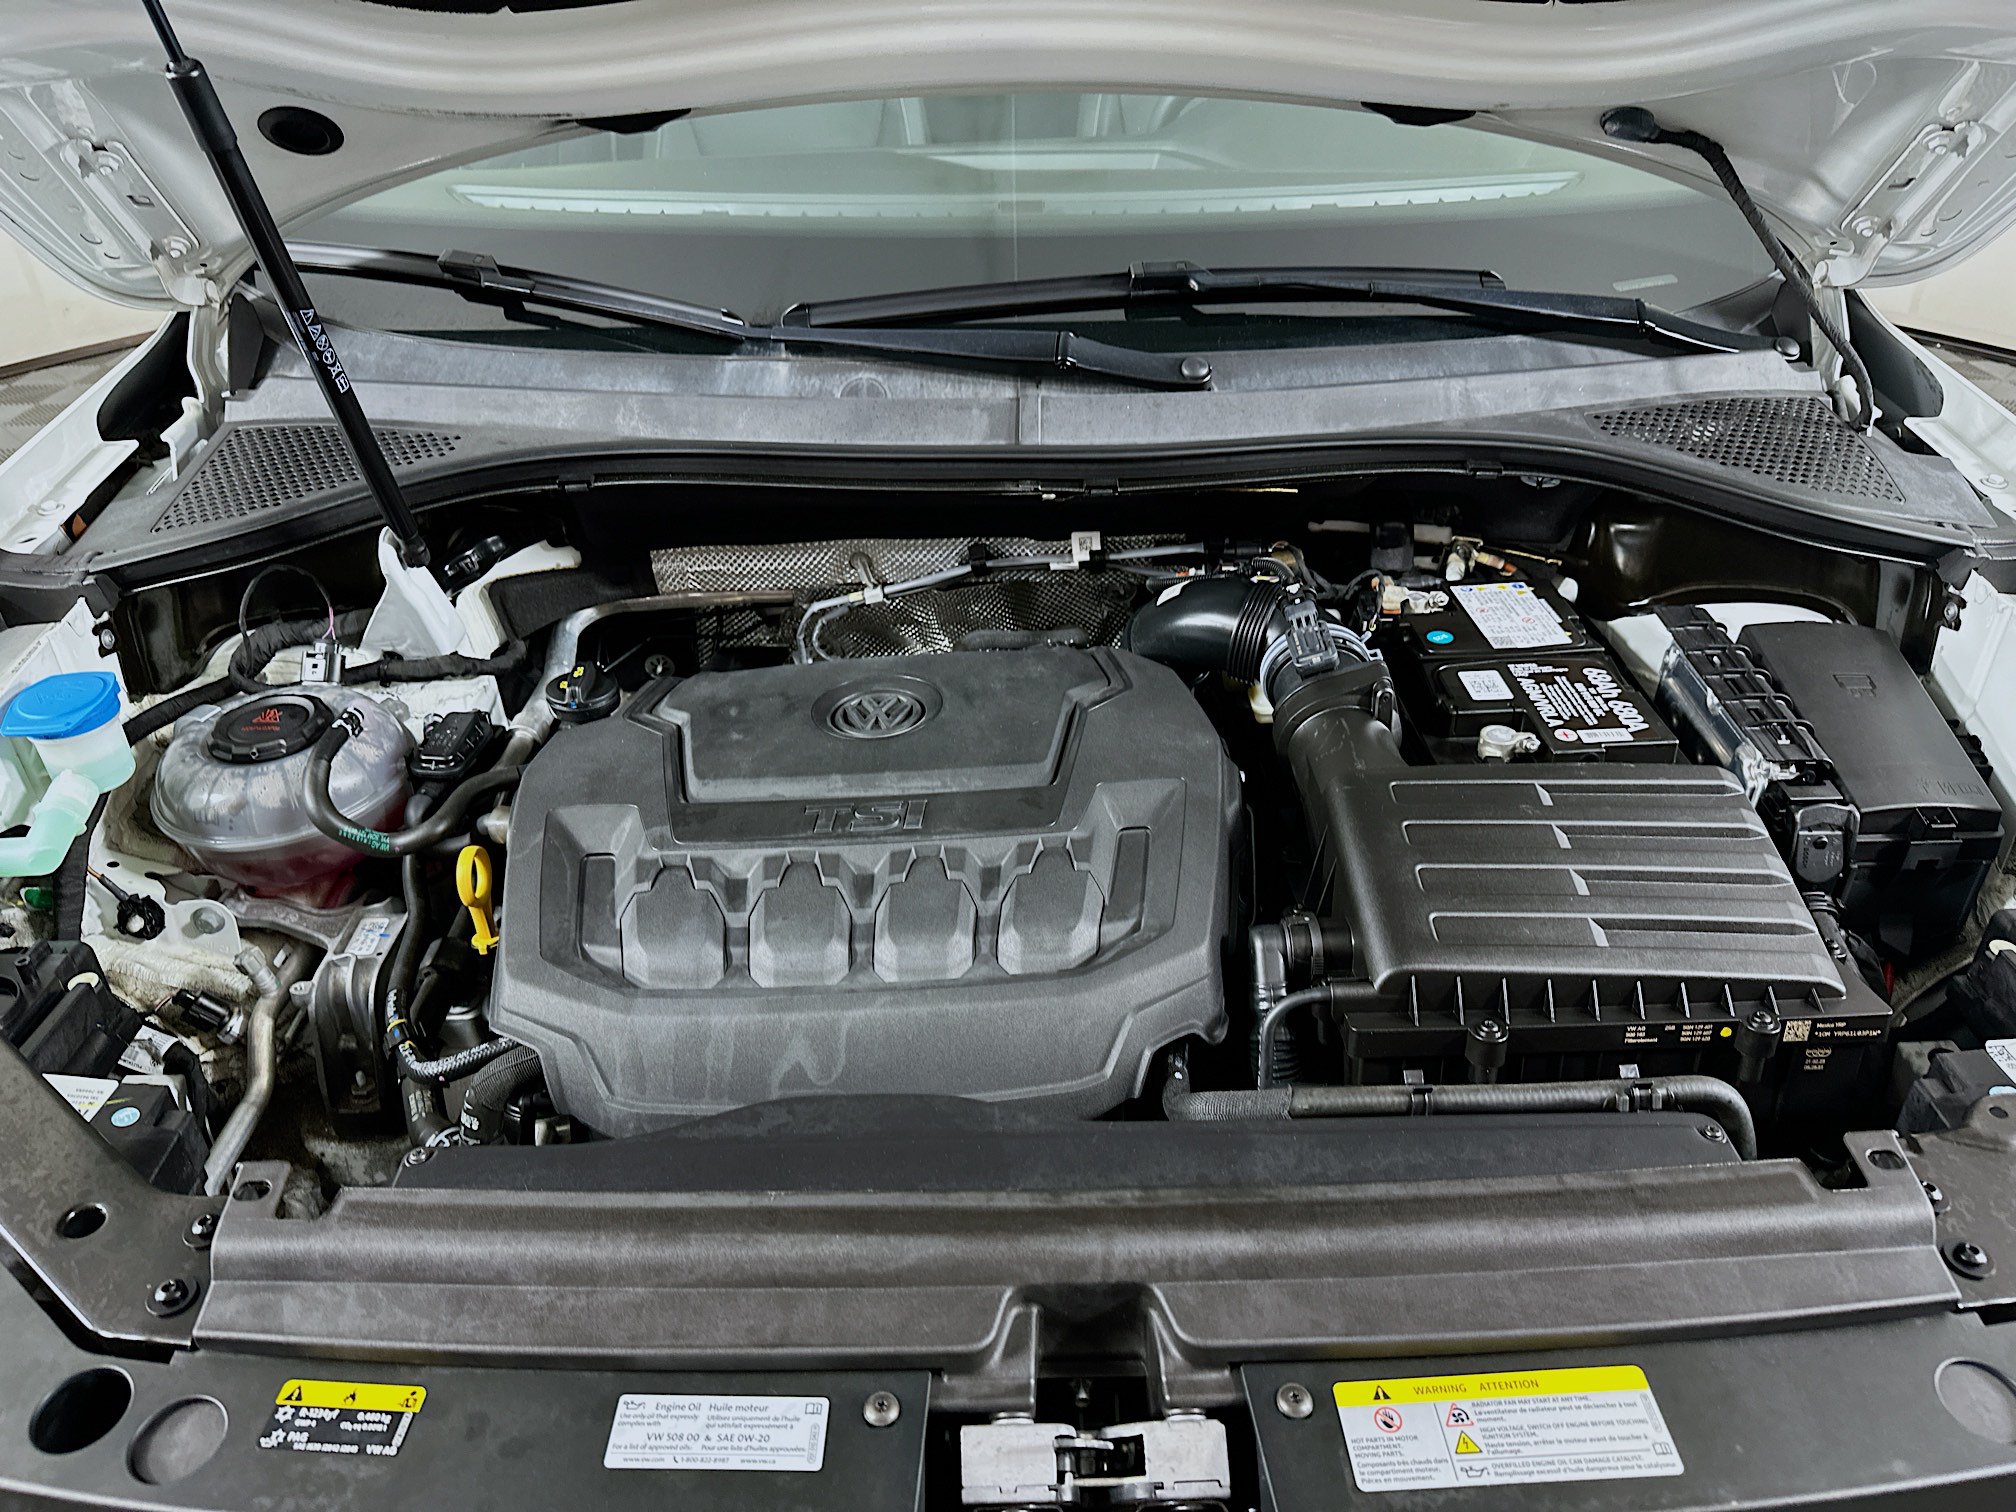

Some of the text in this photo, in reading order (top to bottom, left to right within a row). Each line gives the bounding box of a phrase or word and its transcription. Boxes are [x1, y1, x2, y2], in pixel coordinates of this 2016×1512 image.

[1583, 668, 1622, 698] 68Ah
[1608, 701, 1649, 733] 680A
[805, 800, 927, 833] TSI
[1413, 1380, 1539, 1395] WARNING ATTENTION
[656, 1402, 701, 1412] Engine Oil
[709, 1403, 769, 1412] Huile moteur
[647, 1432, 664, 1441] VW
[666, 1433, 684, 1441] 508
[687, 1433, 700, 1441] 00
[717, 1433, 735, 1442] SAE
[737, 1434, 770, 1442] 0W-20
[1357, 1460, 1396, 1468] Composants
[1491, 1461, 1531, 1469] OVERFILLED
[1367, 1468, 1413, 1476] compartiment
